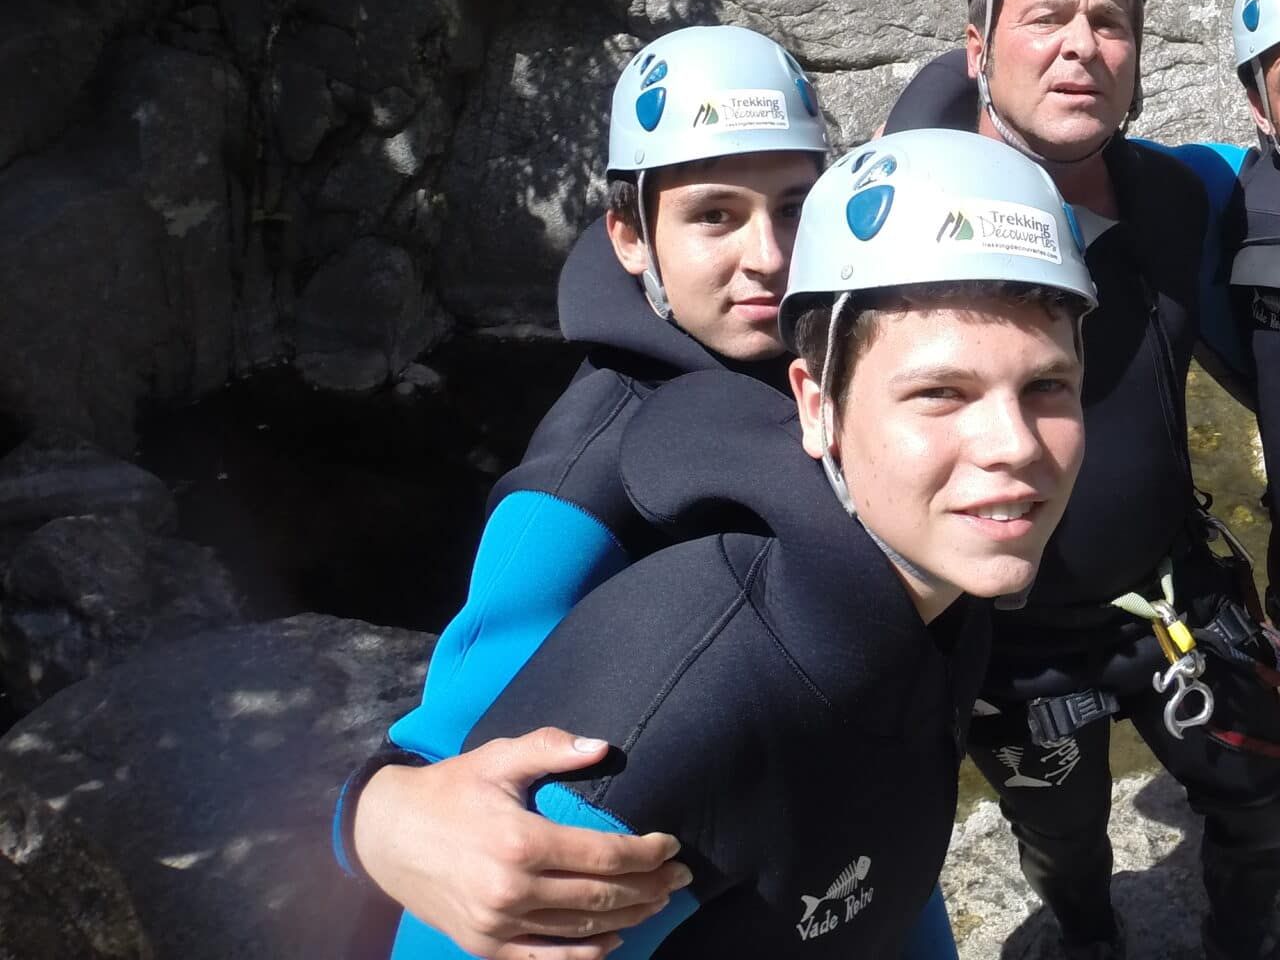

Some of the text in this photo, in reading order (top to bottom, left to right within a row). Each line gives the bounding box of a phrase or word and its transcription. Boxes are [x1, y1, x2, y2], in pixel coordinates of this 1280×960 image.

[731, 96, 780, 111] Trekking
[976, 215, 1057, 252] Découvertes
[988, 210, 1051, 239] Trekking
[796, 887, 874, 941] Vade Retro
